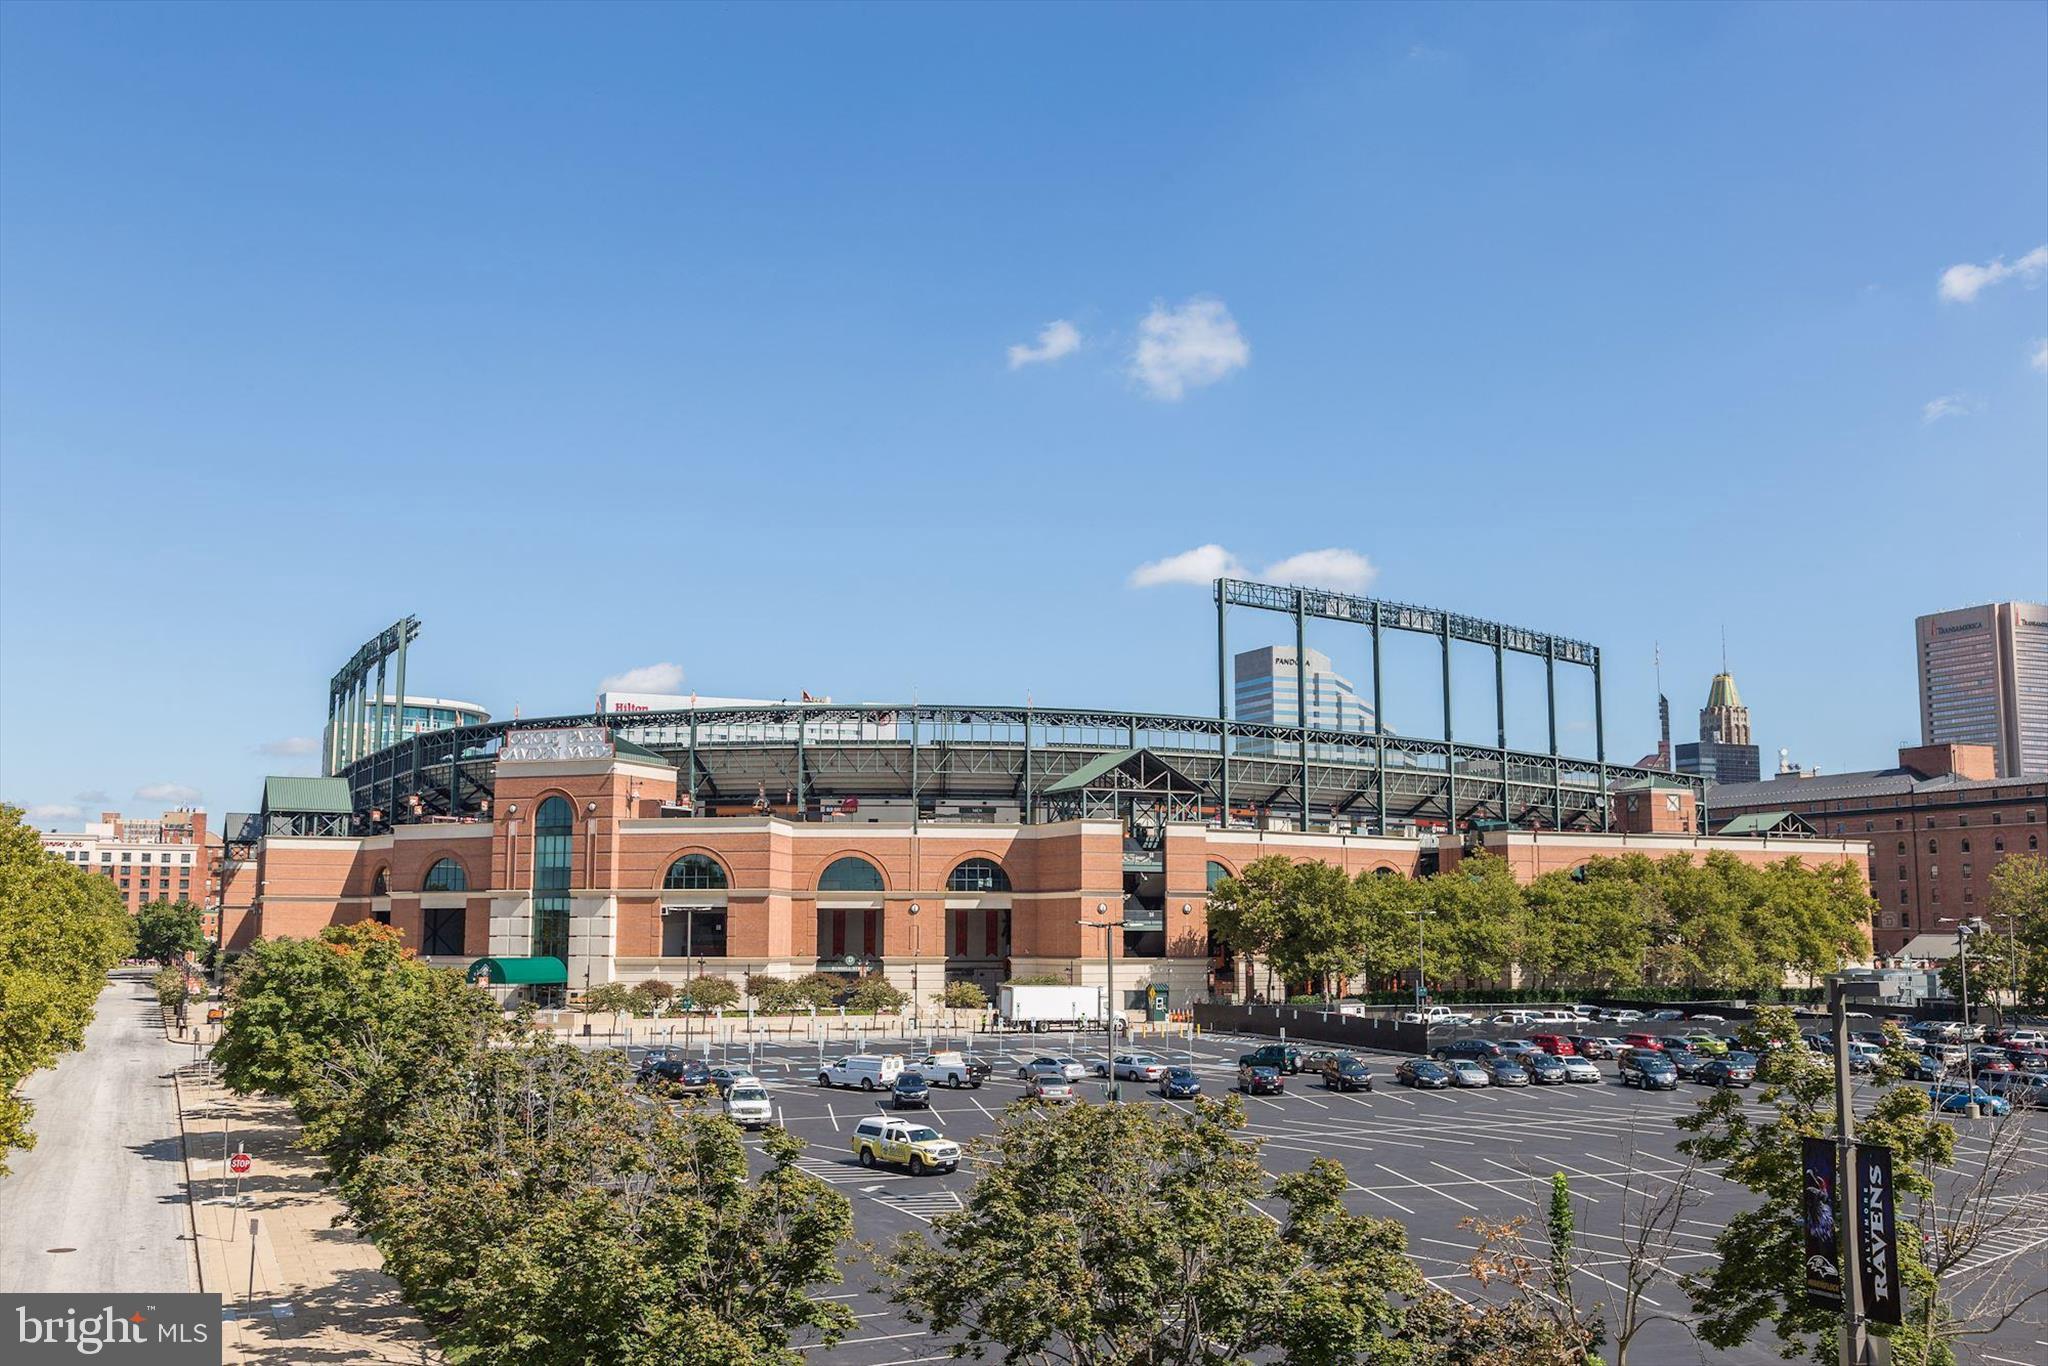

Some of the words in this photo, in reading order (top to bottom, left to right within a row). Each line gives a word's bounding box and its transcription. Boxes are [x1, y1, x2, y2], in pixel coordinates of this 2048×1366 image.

[1275, 657, 1310, 667] PANDOA
[615, 702, 648, 711] Hilton
[569, 730, 604, 742] PARK
[232, 1159, 250, 1168] STOP
[1869, 1163, 1889, 1302] RAVENS
